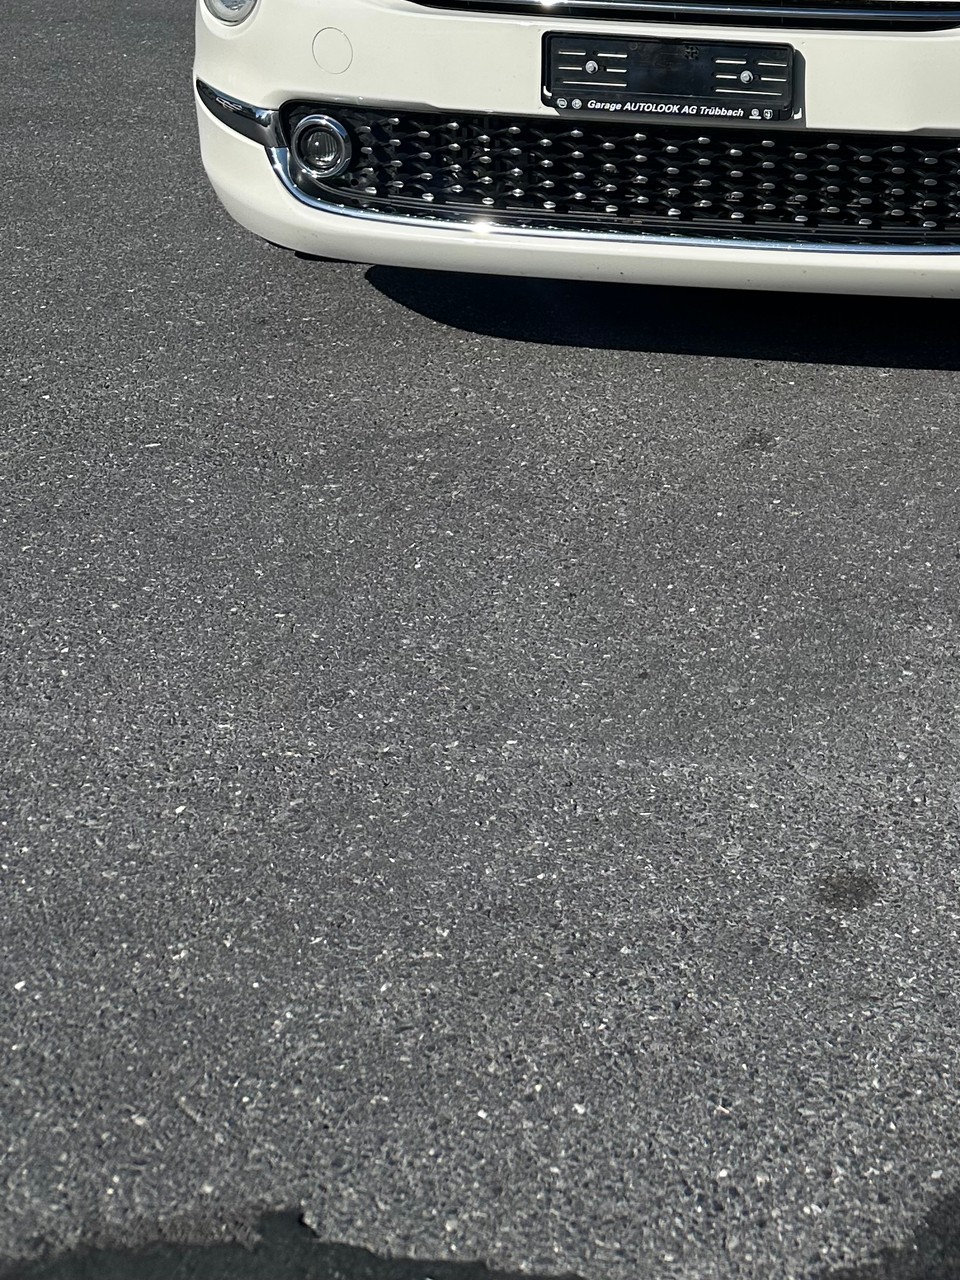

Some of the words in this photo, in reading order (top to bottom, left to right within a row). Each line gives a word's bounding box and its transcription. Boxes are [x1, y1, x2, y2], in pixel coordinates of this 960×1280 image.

[587, 99, 622, 112] Garage
[623, 101, 680, 113] AUTOLOOK
[681, 105, 698, 115] AG
[699, 105, 744, 118] Trübbach
